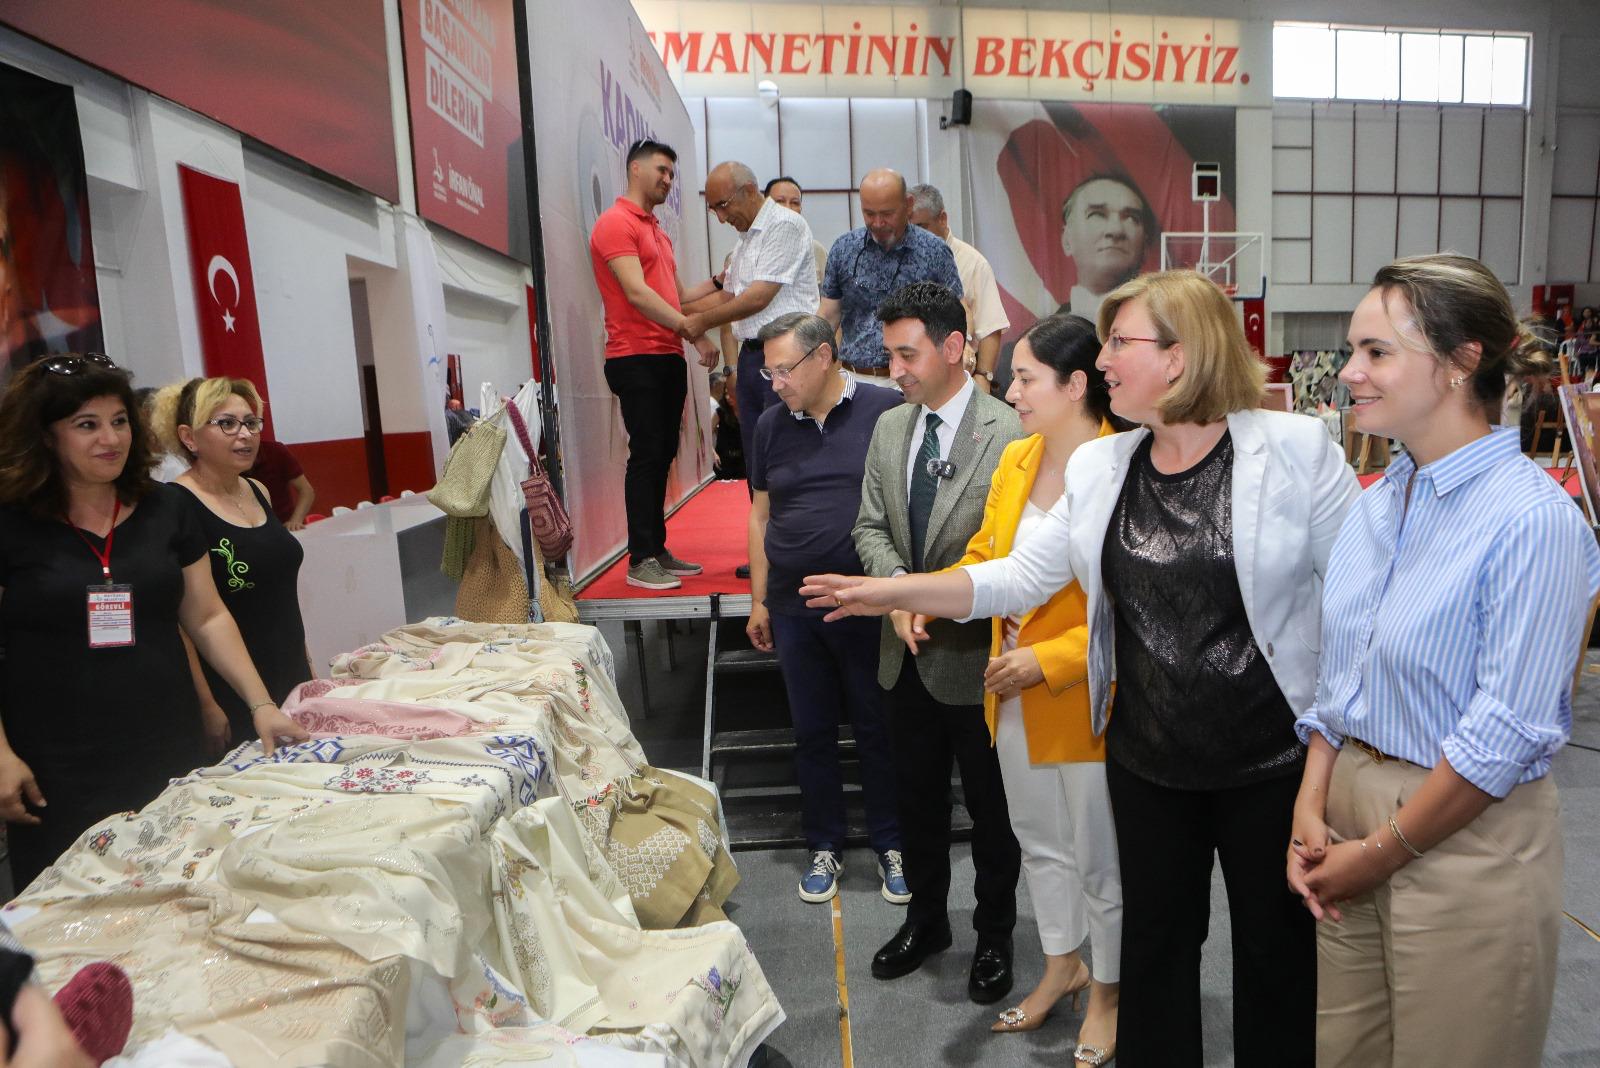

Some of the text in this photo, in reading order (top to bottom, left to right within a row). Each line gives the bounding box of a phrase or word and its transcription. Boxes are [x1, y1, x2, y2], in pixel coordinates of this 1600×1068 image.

[647, 22, 955, 77] MANETİNİN
[973, 29, 1250, 92] BEKÇİSİYİZ.
[430, 63, 483, 142] DİLERİM.
